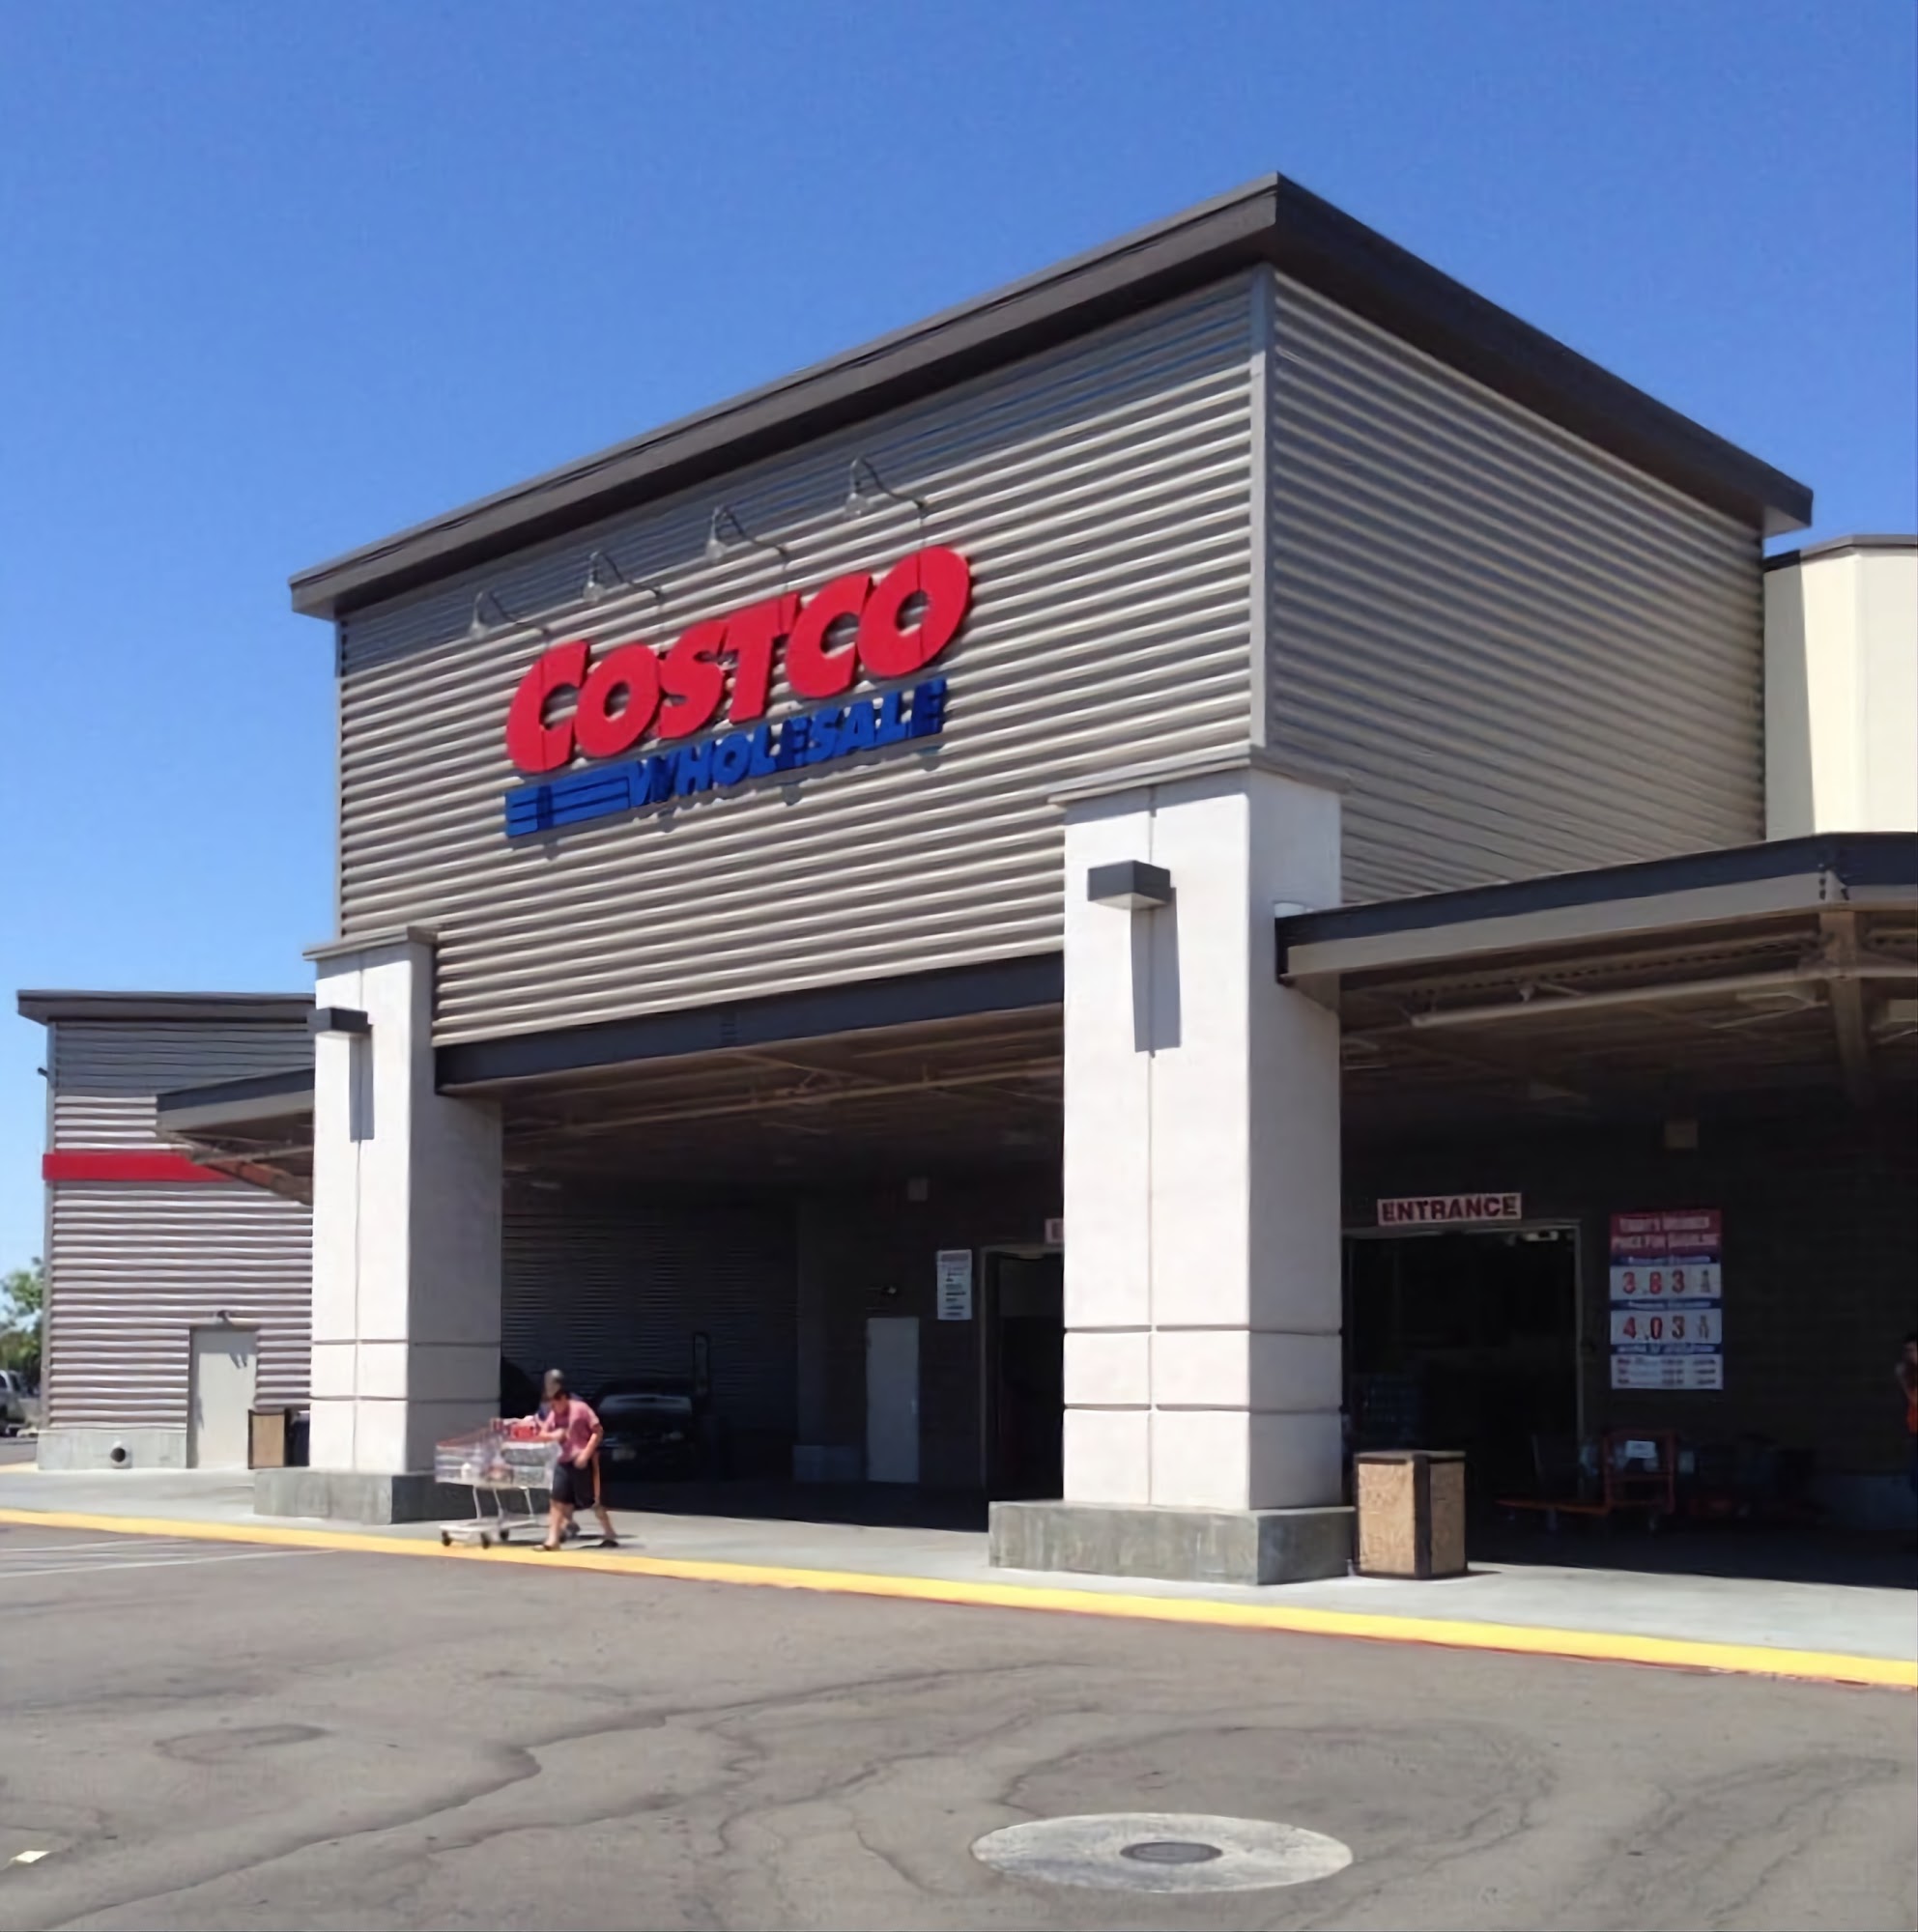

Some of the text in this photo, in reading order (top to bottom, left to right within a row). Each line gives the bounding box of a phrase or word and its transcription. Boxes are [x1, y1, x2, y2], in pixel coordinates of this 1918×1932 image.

[505, 545, 971, 771] COSTCO
[629, 678, 947, 808] WHOLESALE
[1383, 1196, 1518, 1222] ENTRANCE
